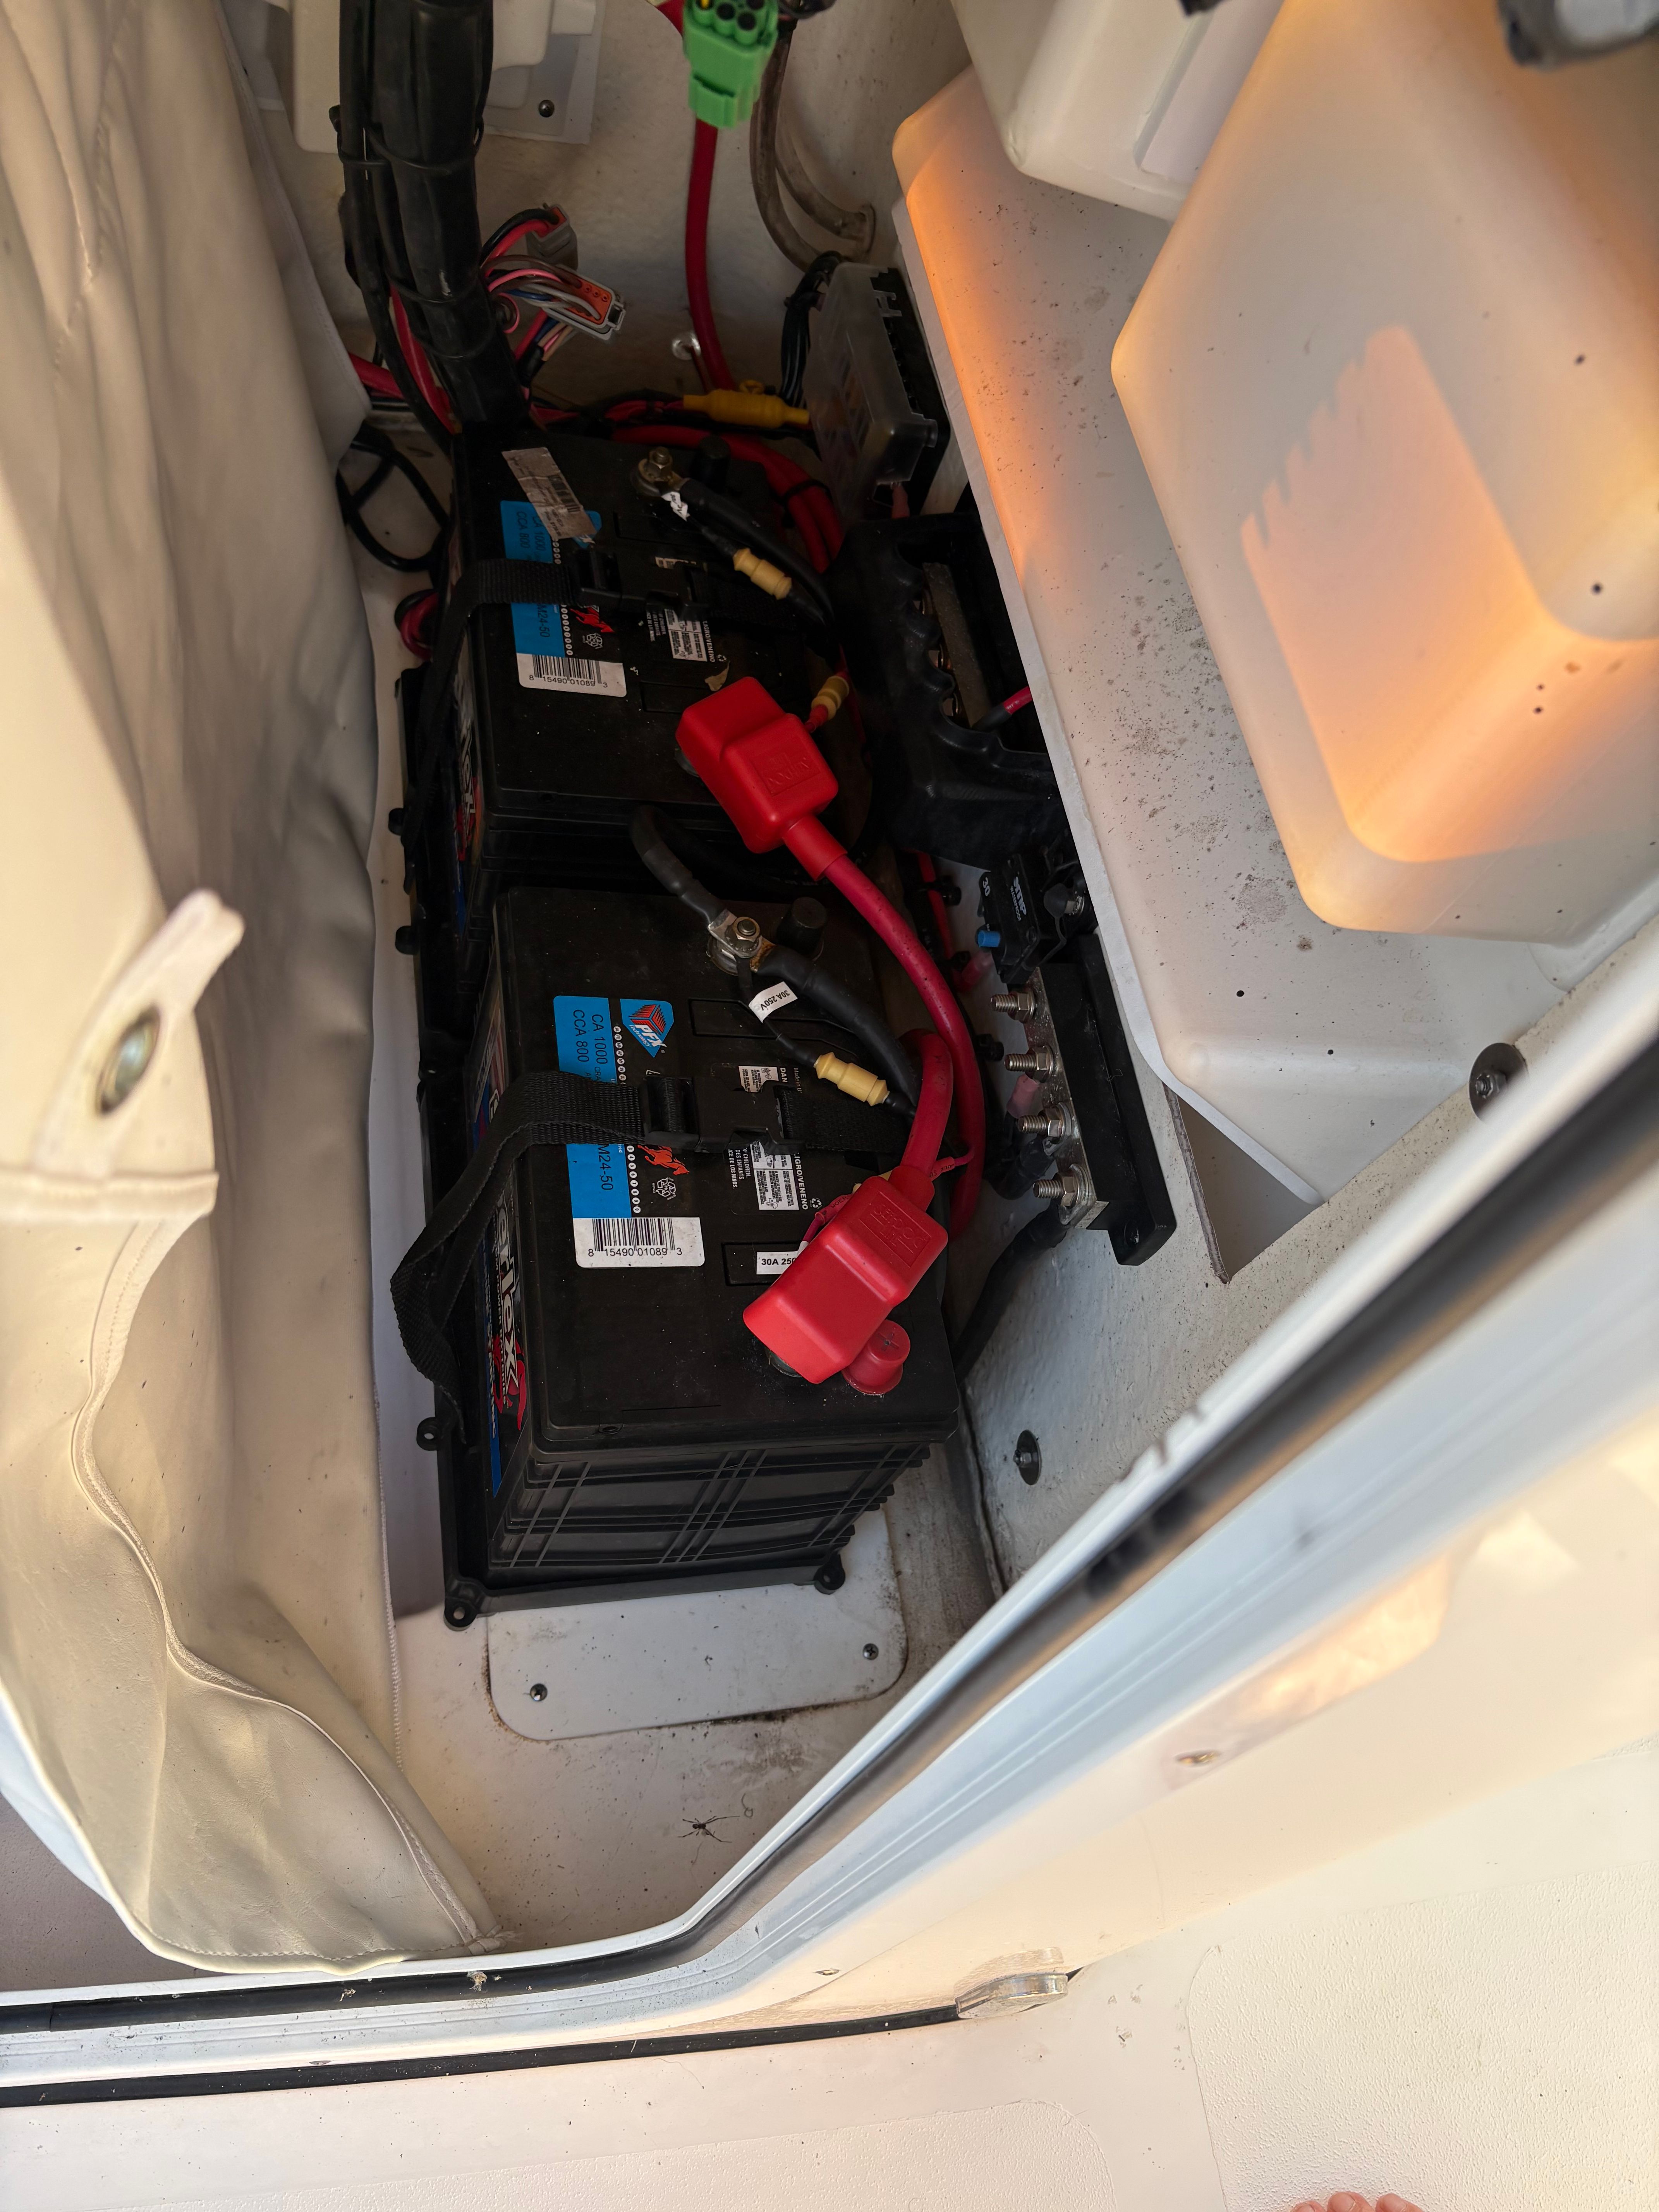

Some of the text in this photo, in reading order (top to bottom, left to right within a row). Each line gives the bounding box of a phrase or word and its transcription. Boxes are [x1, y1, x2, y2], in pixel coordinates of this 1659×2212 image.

[517, 512, 529, 548] CCA 800
[535, 532, 545, 551] 1000
[543, 676, 568, 685] 15490
[570, 678, 596, 687] 01089
[982, 877, 990, 896] 30
[761, 990, 790, 1011] 30A 250V
[573, 1010, 586, 1036] CCA
[592, 1014, 608, 1064] CA 1000
[629, 1025, 652, 1047] Technology
[634, 1025, 667, 1047] PFX
[577, 1041, 589, 1062] 800
[588, 1248, 682, 1257] 8 15490 01089 3
